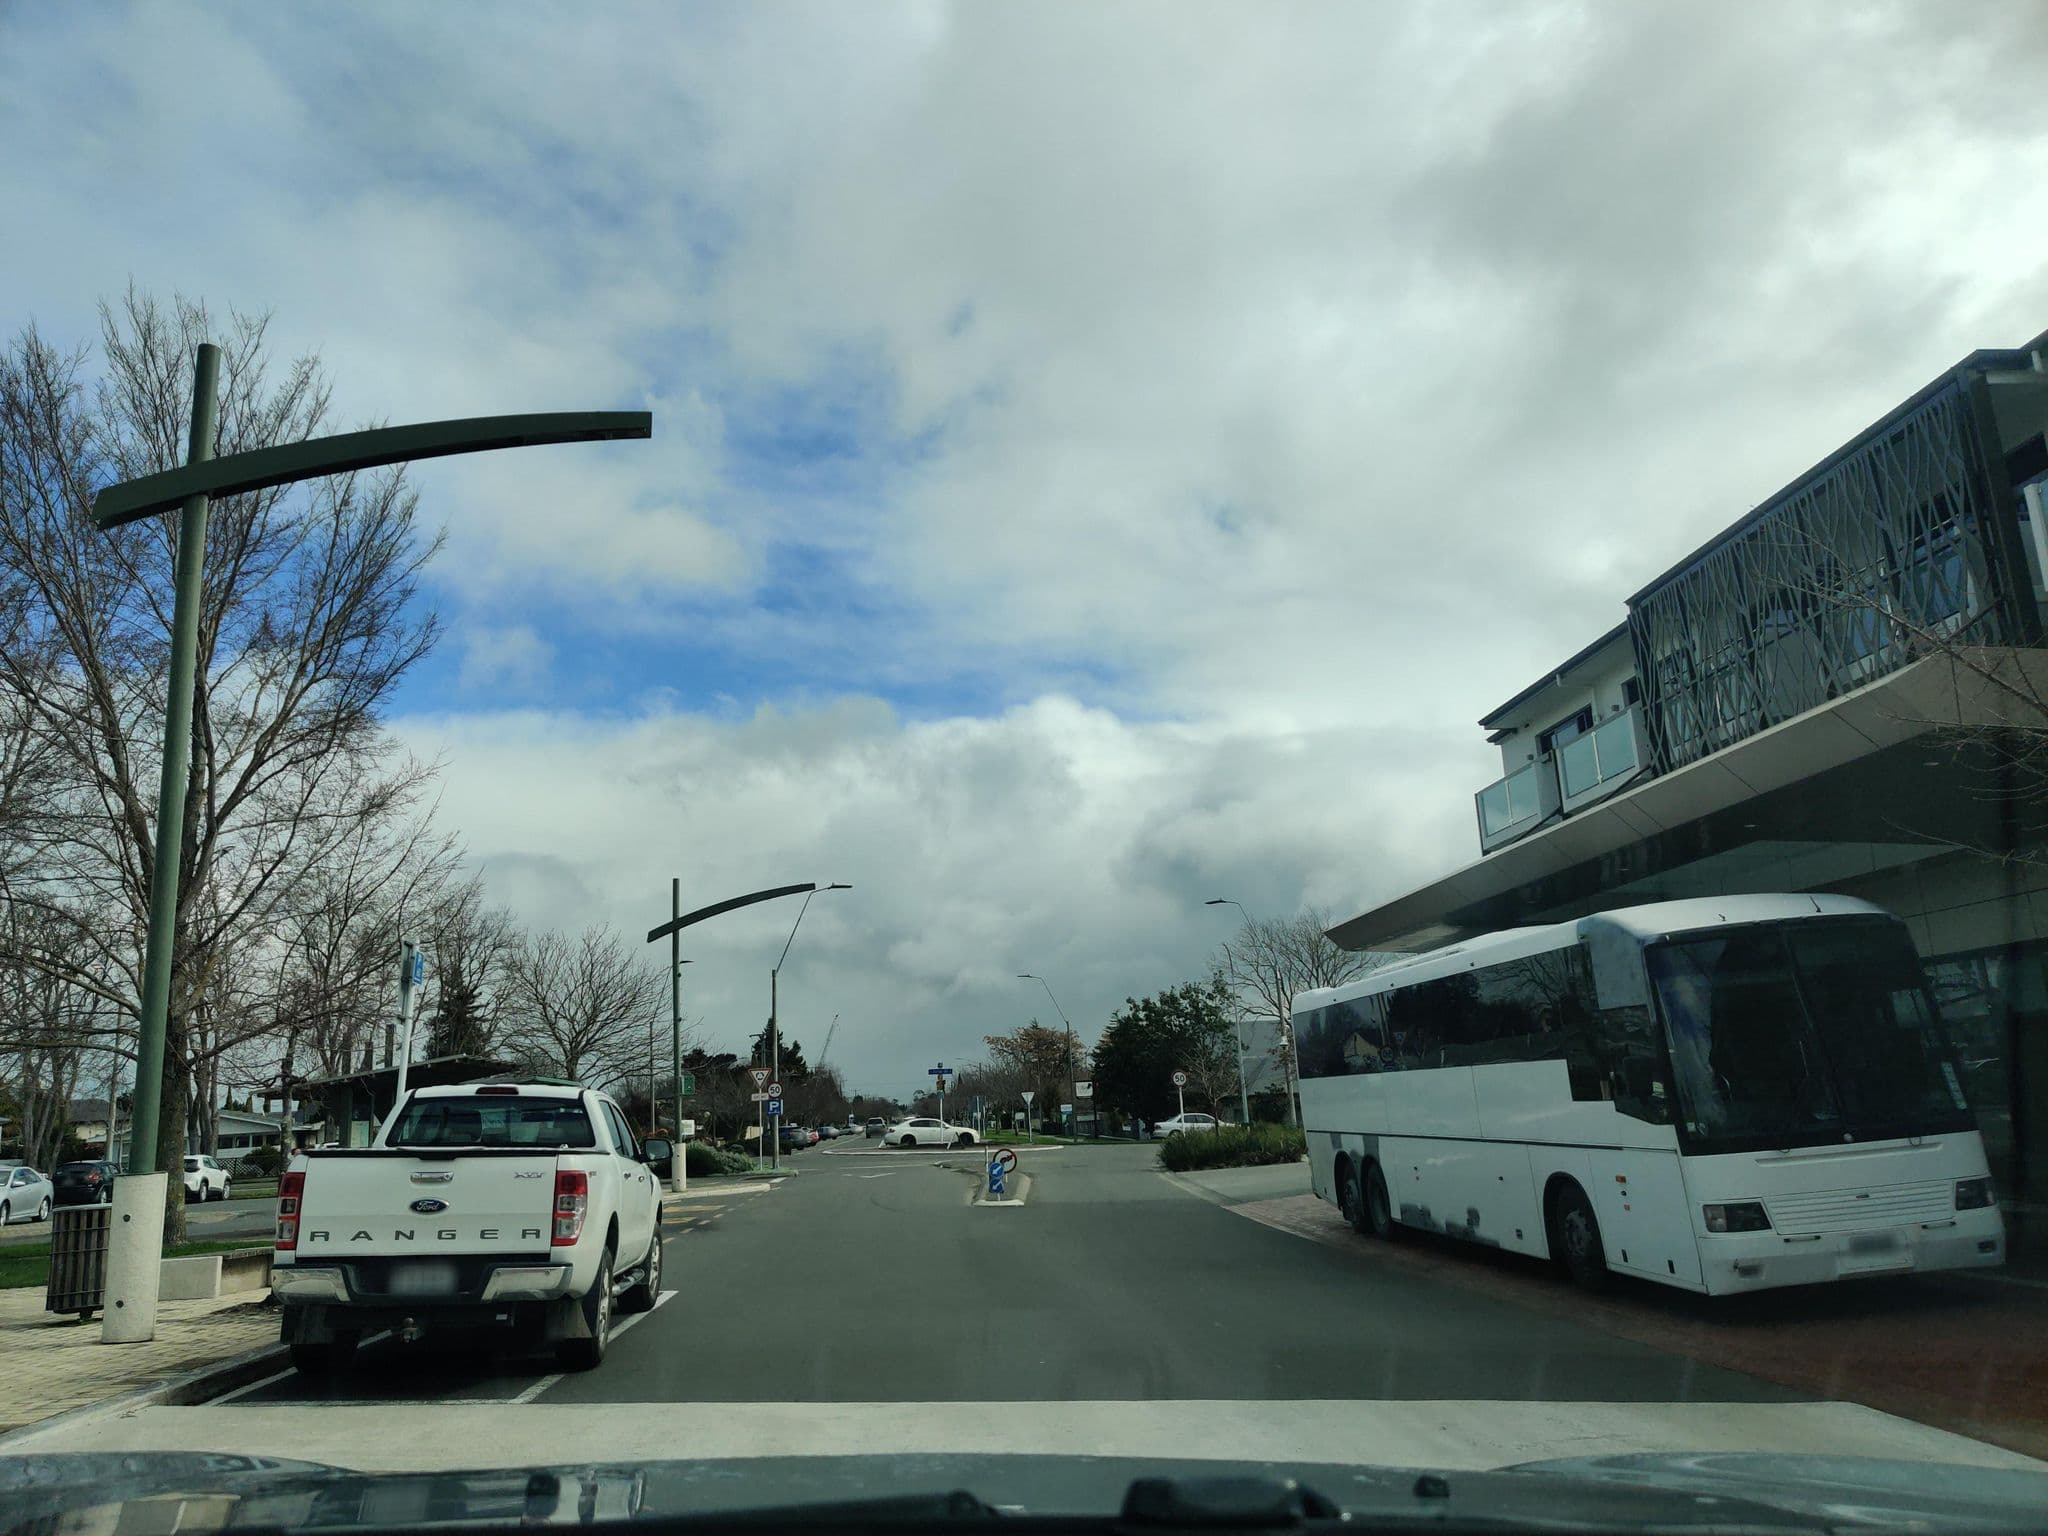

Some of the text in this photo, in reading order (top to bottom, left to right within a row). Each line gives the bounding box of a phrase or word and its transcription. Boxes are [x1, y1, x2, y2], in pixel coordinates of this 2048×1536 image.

[1174, 1074, 1185, 1083] 50
[770, 1086, 780, 1094] 50
[769, 1101, 779, 1111] P
[415, 1200, 440, 1211] Ford
[309, 1228, 541, 1242] RANGER
